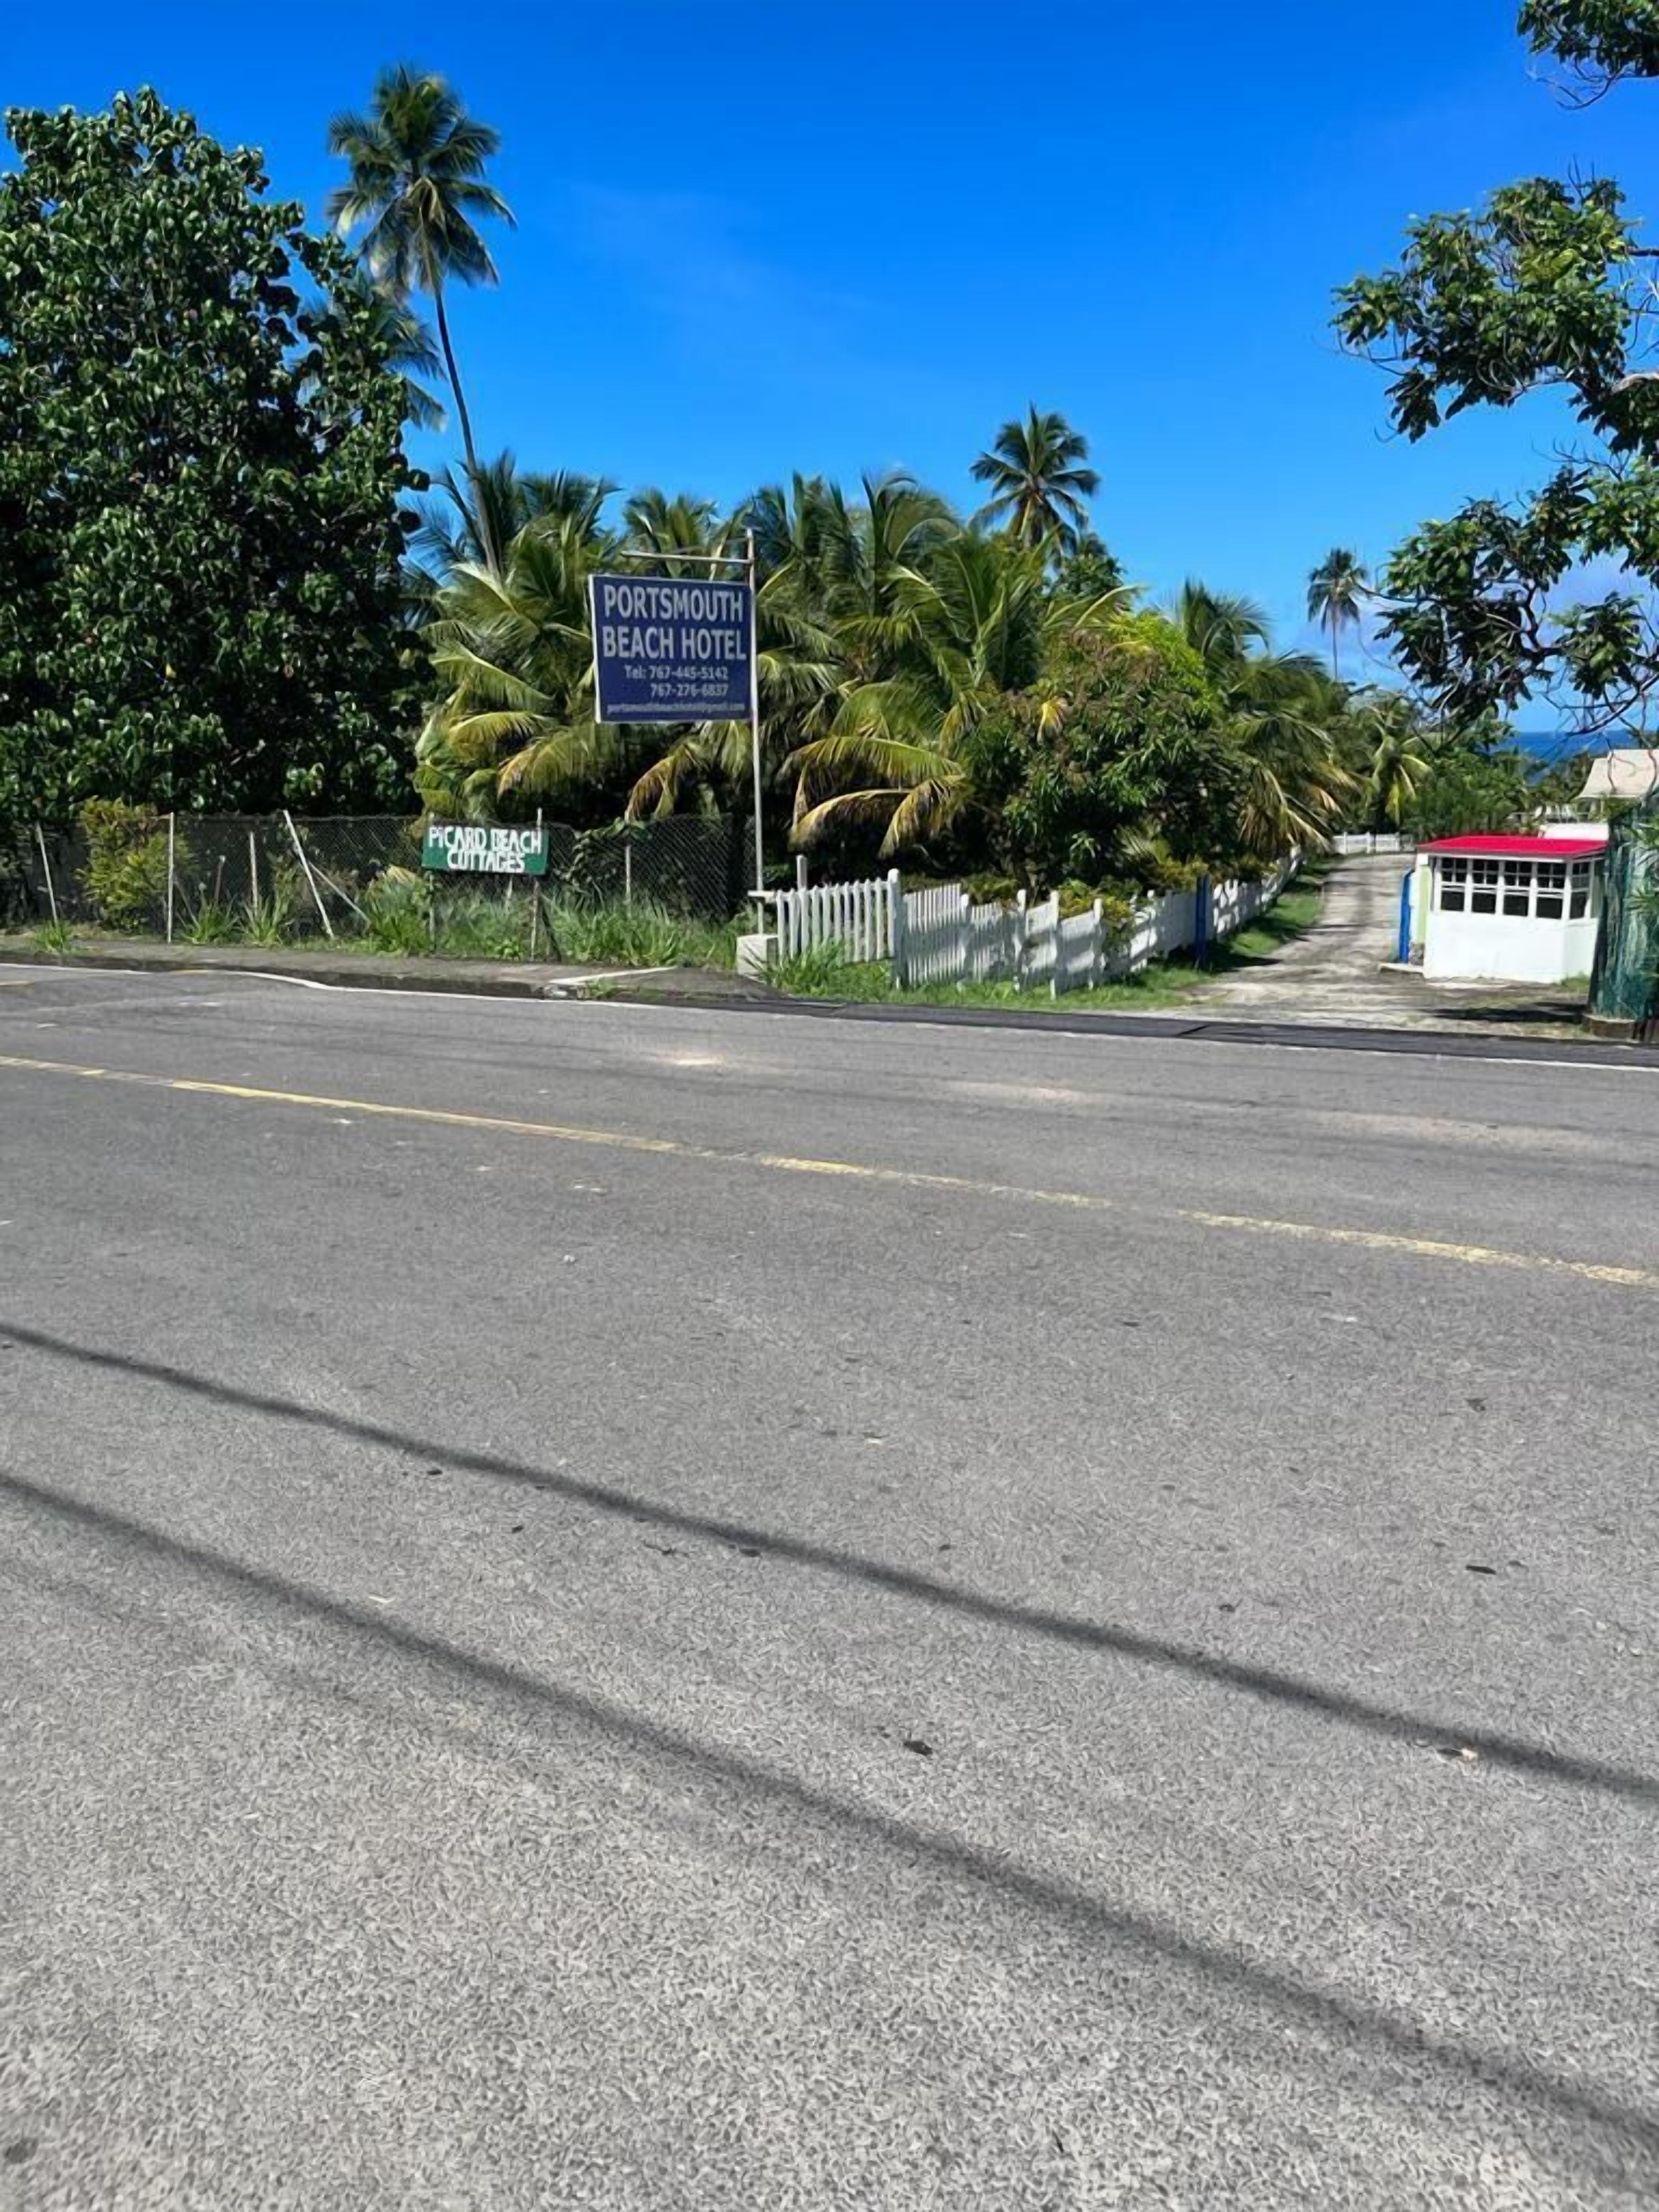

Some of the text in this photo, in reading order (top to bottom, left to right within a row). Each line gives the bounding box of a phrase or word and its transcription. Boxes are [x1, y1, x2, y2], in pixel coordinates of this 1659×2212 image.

[603, 584, 743, 622] PORTSMOUTH
[602, 625, 747, 660] BEACH HOTEL
[490, 827, 542, 854] BEACH
